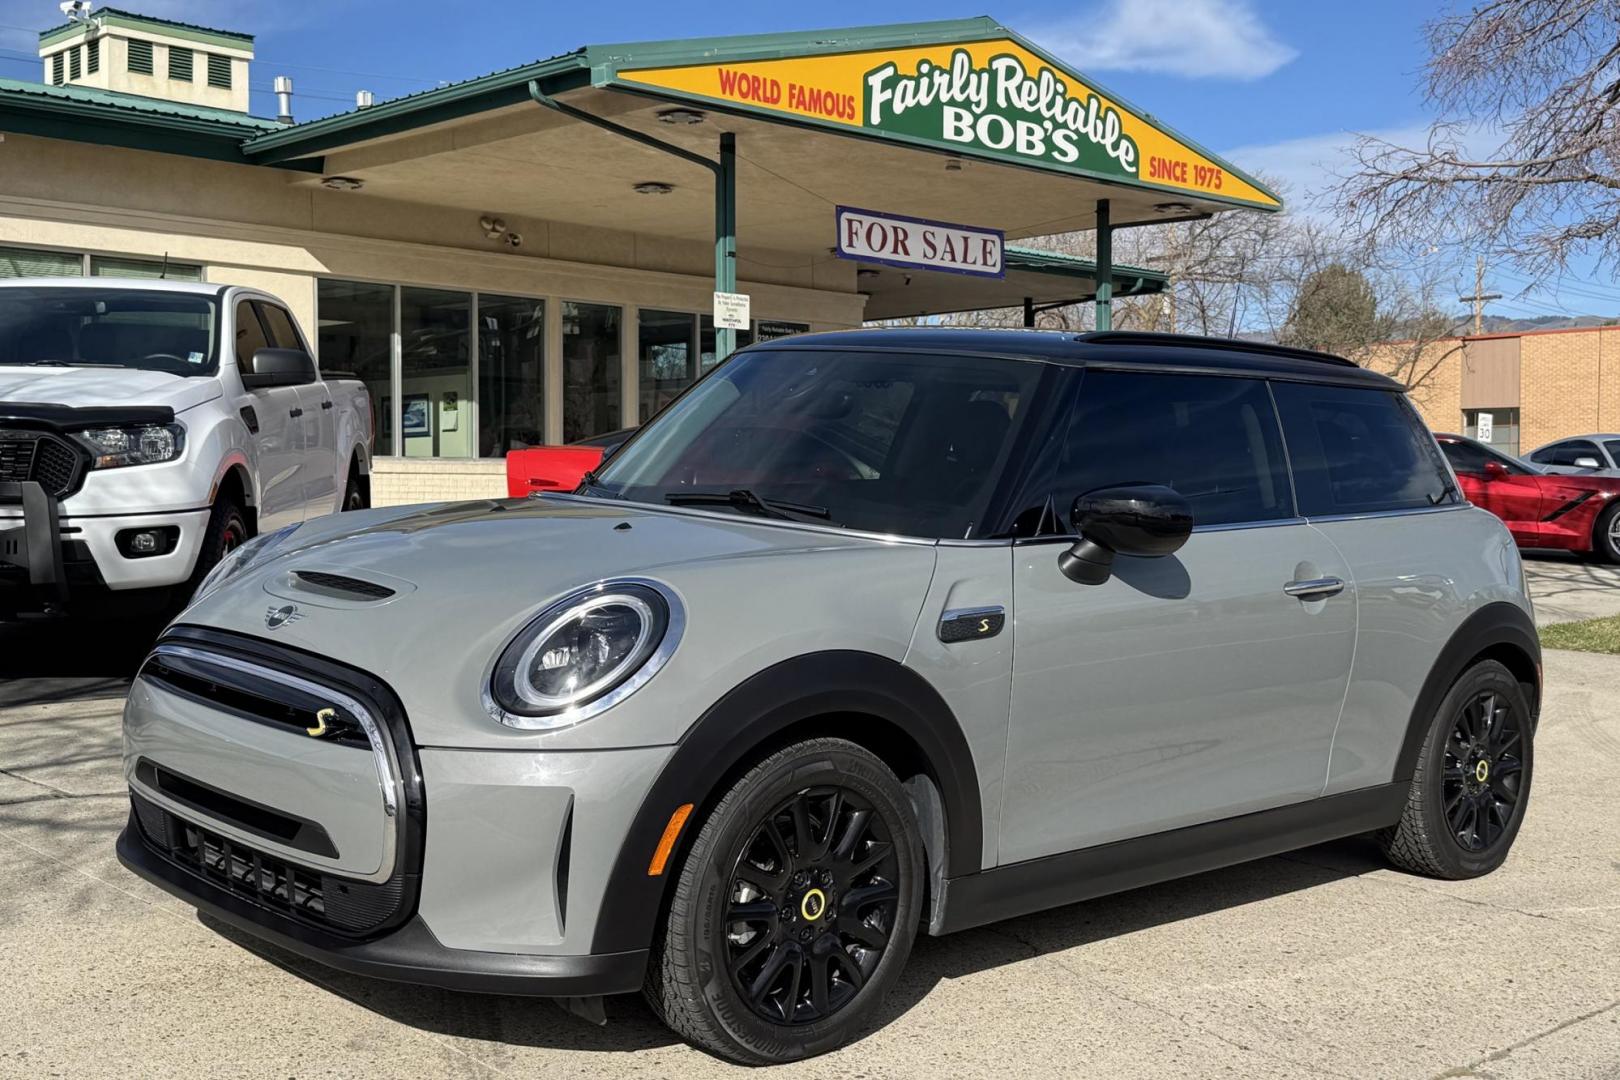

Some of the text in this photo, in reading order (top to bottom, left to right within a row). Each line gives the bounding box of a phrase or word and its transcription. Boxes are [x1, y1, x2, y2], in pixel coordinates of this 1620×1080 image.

[718, 68, 856, 121] WORLD FAMOUS
[868, 52, 1137, 173] Fairly Reliable
[943, 105, 1080, 163] BOB'S
[1149, 156, 1222, 190] SINCE 1975
[845, 218, 998, 268] FOR SALE
[1480, 428, 1490, 439] 30
[978, 618, 989, 632] S
[306, 707, 336, 737] S
